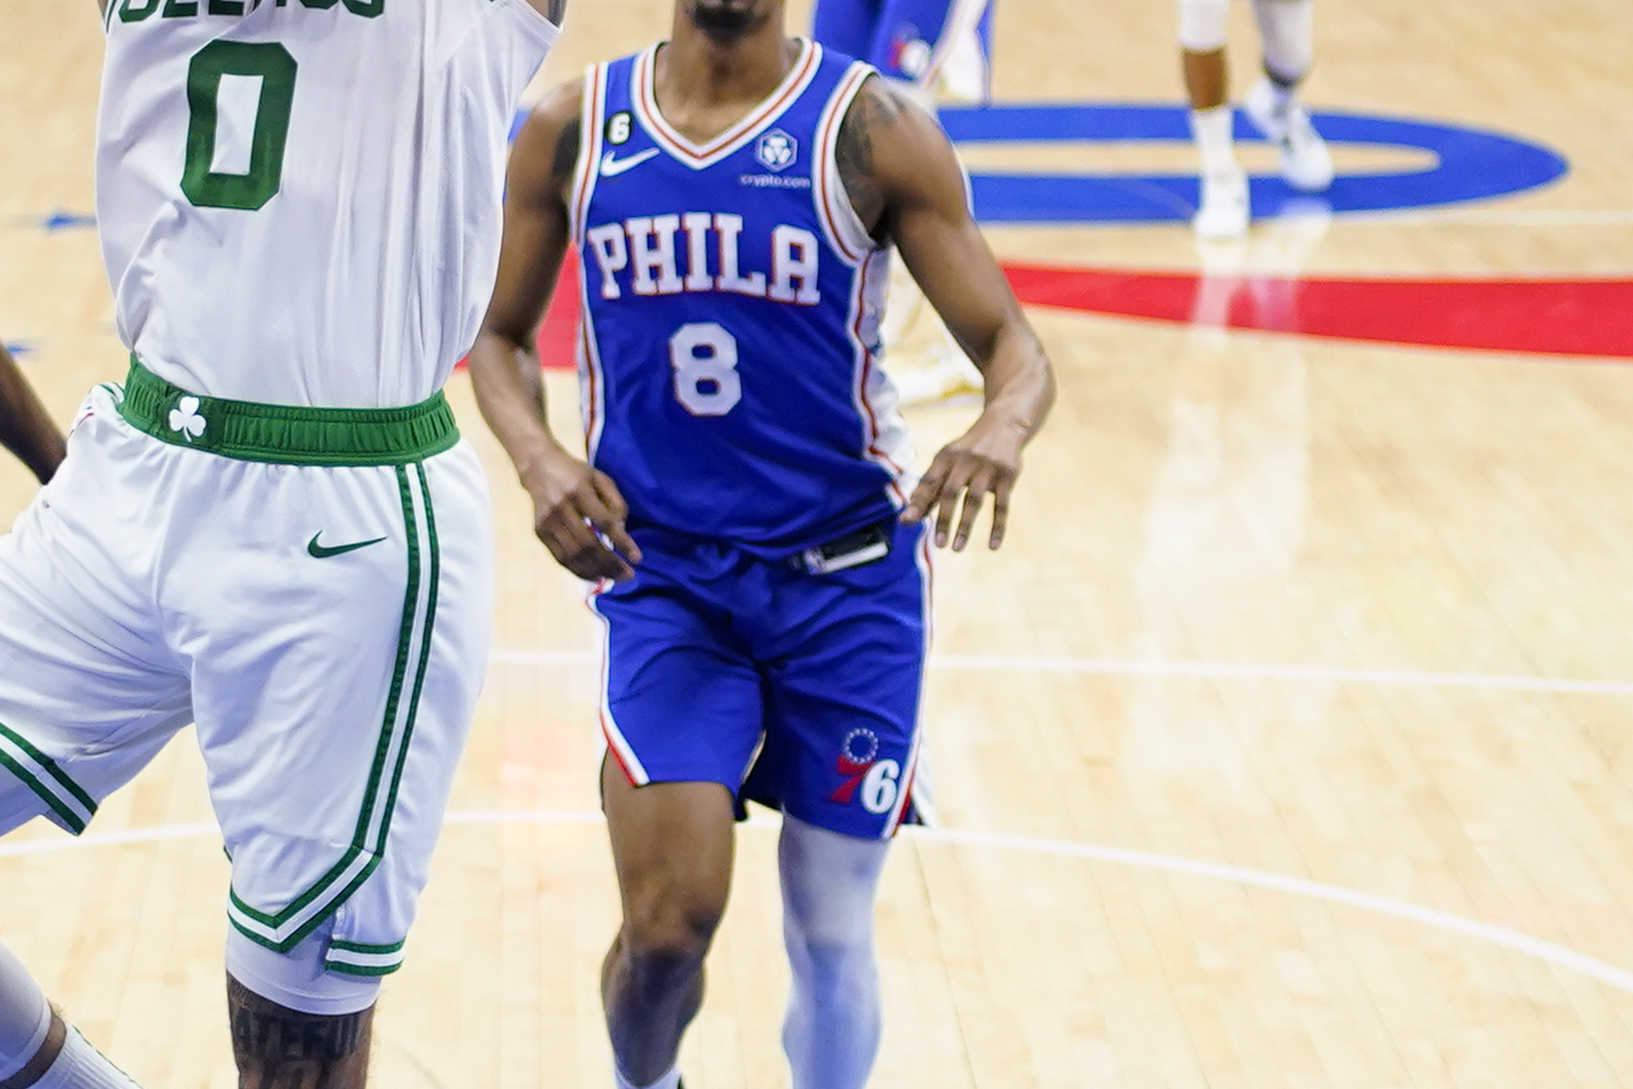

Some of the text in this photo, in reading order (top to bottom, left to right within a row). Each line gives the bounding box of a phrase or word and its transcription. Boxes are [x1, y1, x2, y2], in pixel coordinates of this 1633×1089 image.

[179, 39, 298, 211] 0
[608, 113, 631, 144] 6
[741, 174, 811, 189] crypto.com
[587, 212, 821, 305] PHILA
[669, 322, 742, 416] 8
[830, 755, 900, 814] 76
